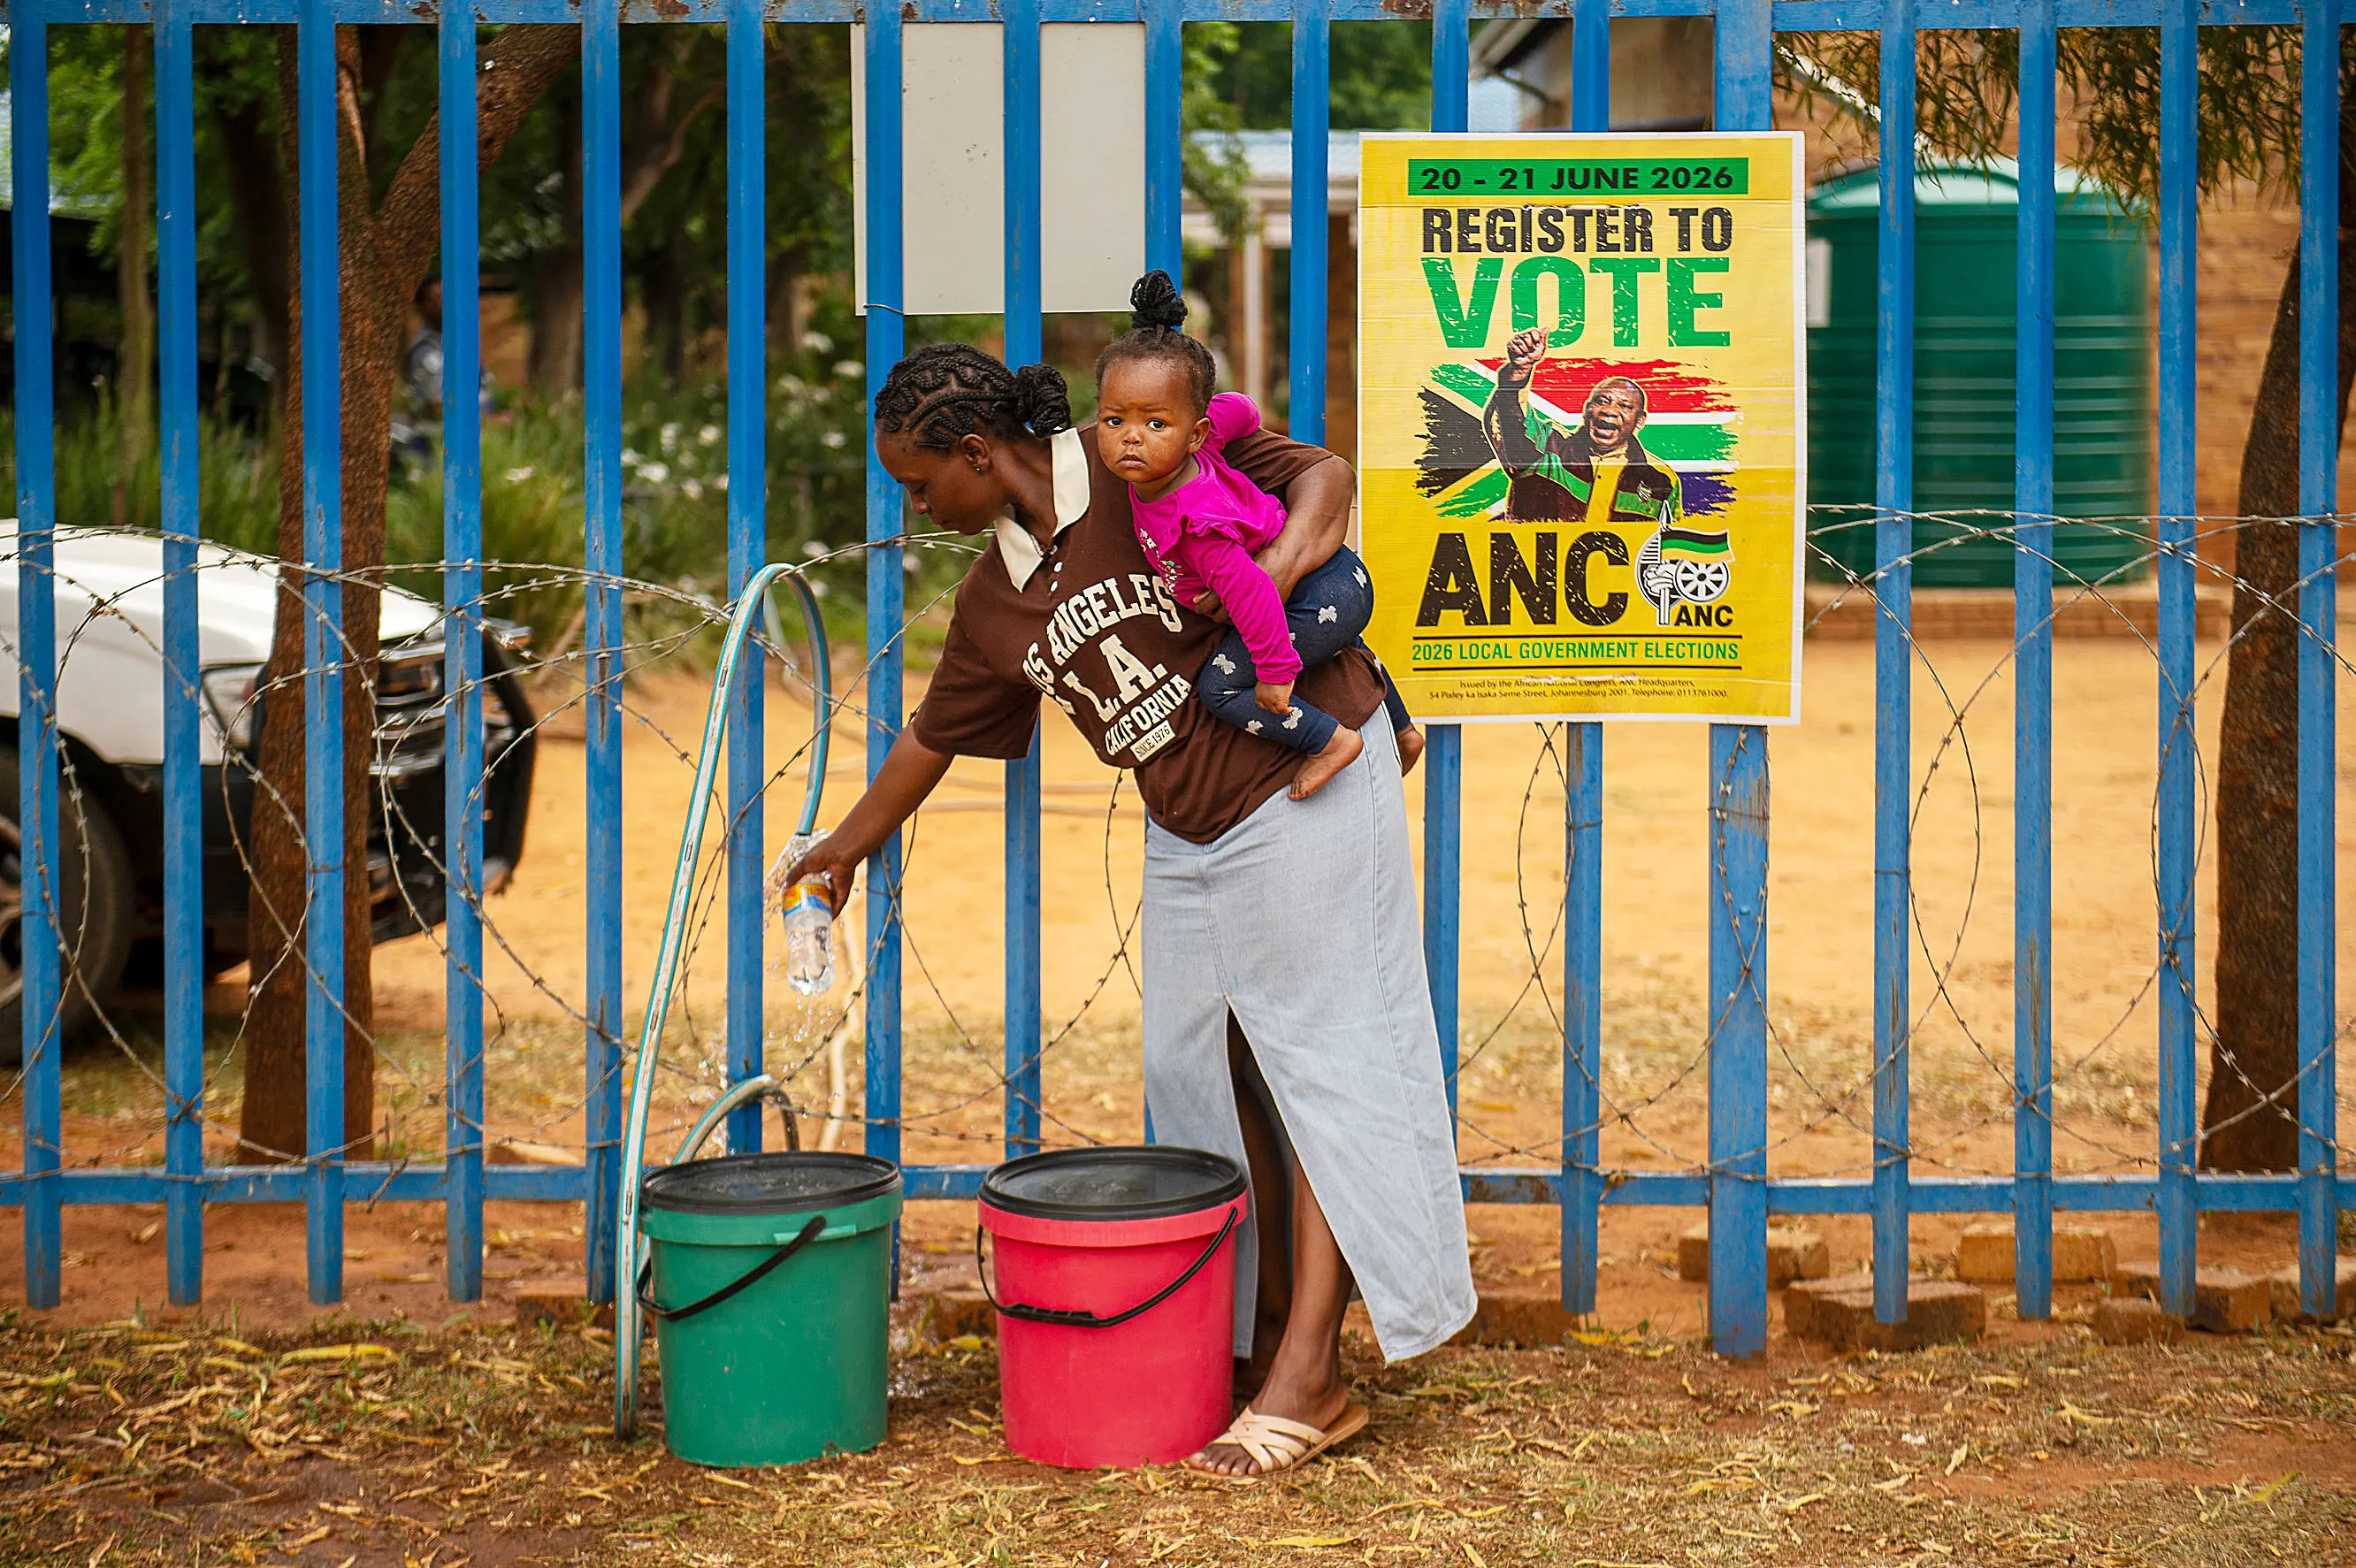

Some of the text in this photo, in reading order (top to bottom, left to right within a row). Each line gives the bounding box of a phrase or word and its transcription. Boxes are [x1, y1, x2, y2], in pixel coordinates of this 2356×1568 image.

[1420, 168, 1461, 190] 20
[1498, 168, 1534, 189] 21
[1549, 167, 1639, 189] JUNE
[1651, 166, 1733, 188] 2026
[1422, 207, 1733, 253] REGISTER TO
[1420, 256, 1731, 348] VOTE
[1415, 532, 1629, 627] ANC
[1046, 574, 1182, 666] ANGELES
[1674, 605, 1733, 626] ANC
[1412, 642, 1739, 661] 2026 LOCAL GOVERNMENT ELECTIONS
[1487, 679, 1496, 689] by
[1105, 674, 1191, 755] CALIFORNIA
[1151, 724, 1170, 743] 1976
